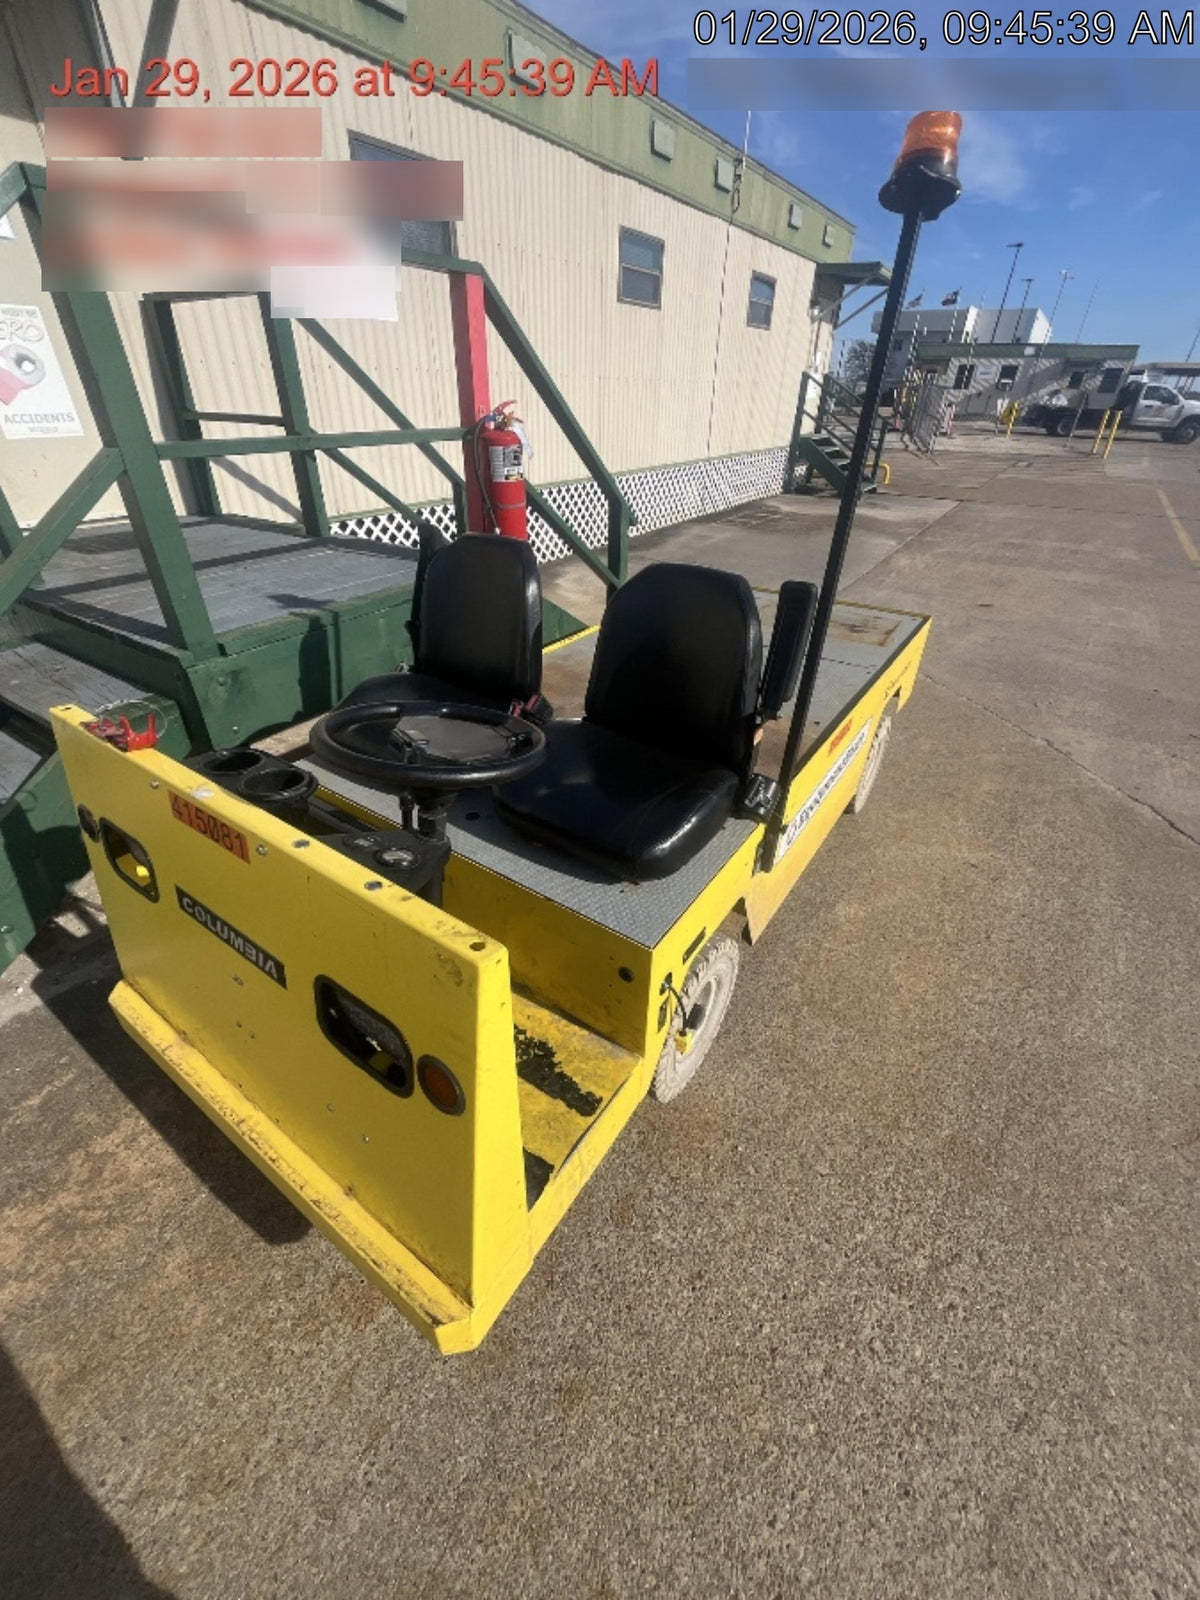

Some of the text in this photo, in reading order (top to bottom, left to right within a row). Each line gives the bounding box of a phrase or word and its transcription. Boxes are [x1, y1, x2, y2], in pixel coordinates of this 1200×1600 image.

[4, 413, 75, 425] ACCIDENTS
[171, 793, 246, 860] 415081
[181, 895, 279, 980] COLUMBIA
